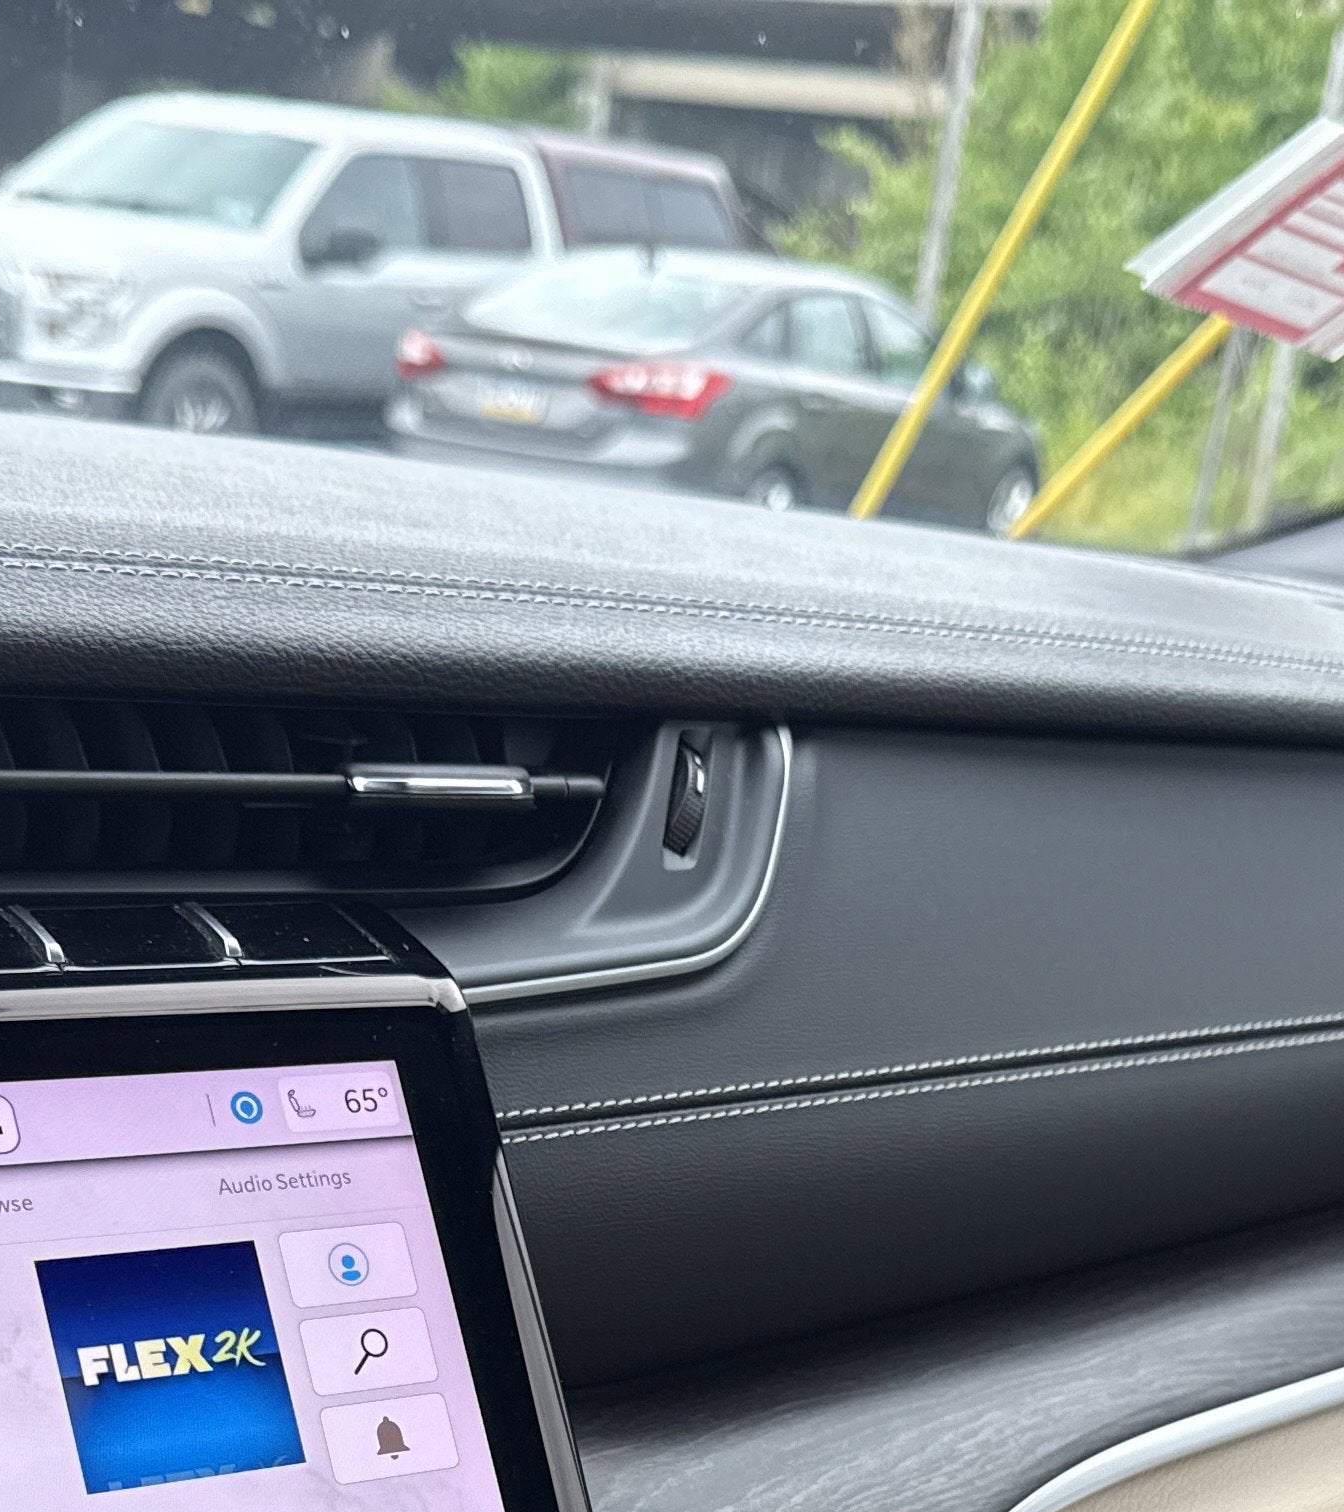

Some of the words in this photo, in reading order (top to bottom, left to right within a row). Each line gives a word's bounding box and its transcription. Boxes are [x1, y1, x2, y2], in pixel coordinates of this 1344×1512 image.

[343, 1085, 389, 1115] 65°
[218, 1173, 274, 1196] Audio
[277, 1167, 352, 1194] Settings
[77, 1333, 213, 1387] FLEX
[212, 1328, 266, 1368] 2K
